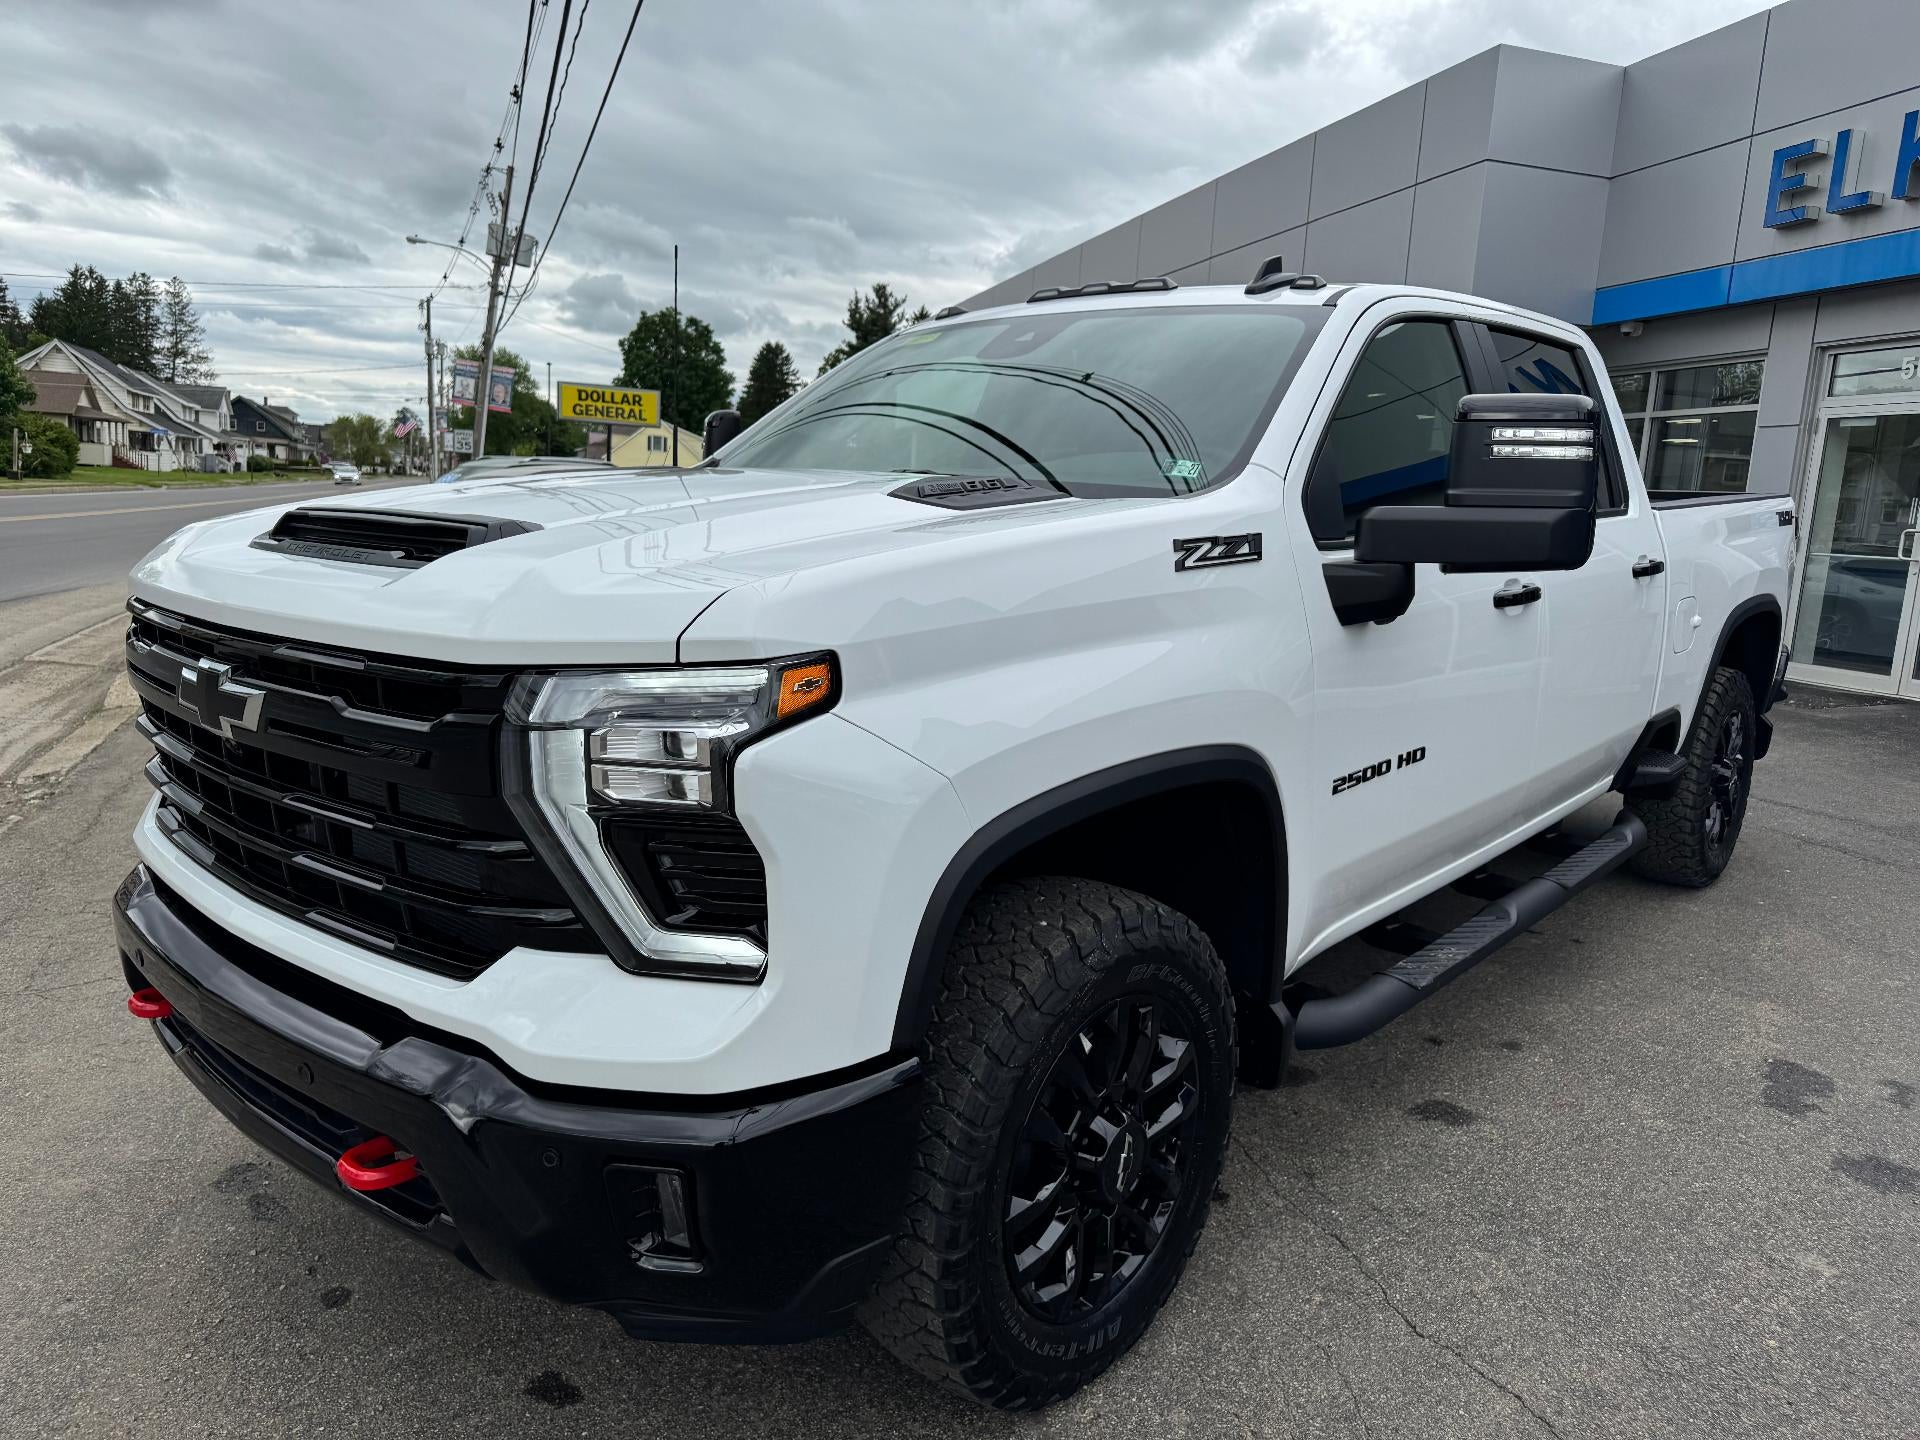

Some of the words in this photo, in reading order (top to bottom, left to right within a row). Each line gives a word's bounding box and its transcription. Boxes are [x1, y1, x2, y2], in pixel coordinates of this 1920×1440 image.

[577, 388, 643, 407] DOLLAR
[572, 403, 647, 422] GENERAL
[456, 440, 472, 451] 35
[1187, 463, 1200, 475] 27
[286, 542, 377, 561] CHEVROLET
[1172, 532, 1263, 573] Z71
[1332, 758, 1392, 796] 2500
[1397, 745, 1427, 770] HD
